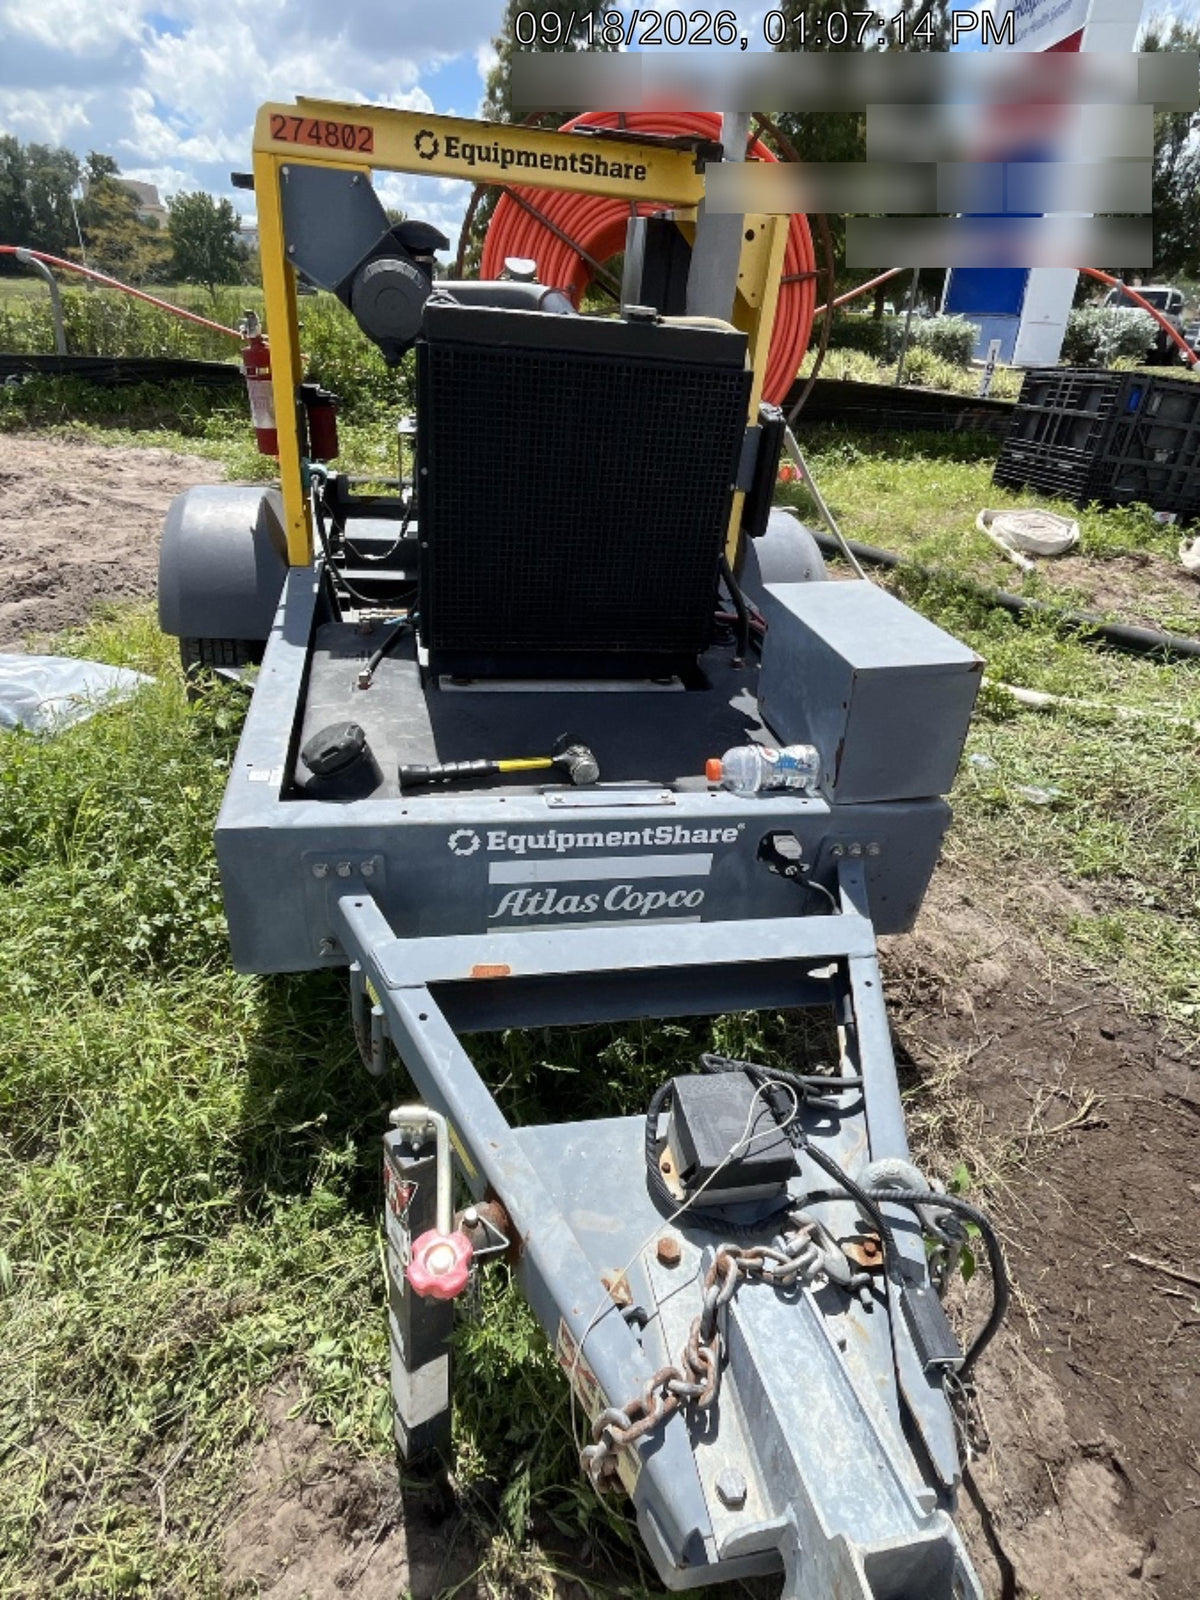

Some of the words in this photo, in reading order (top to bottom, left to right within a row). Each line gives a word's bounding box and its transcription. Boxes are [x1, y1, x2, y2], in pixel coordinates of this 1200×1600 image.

[271, 113, 374, 153] 274802
[444, 135, 648, 182] EquipmentShare
[488, 887, 600, 919] Atlas
[603, 884, 706, 917] Copco
